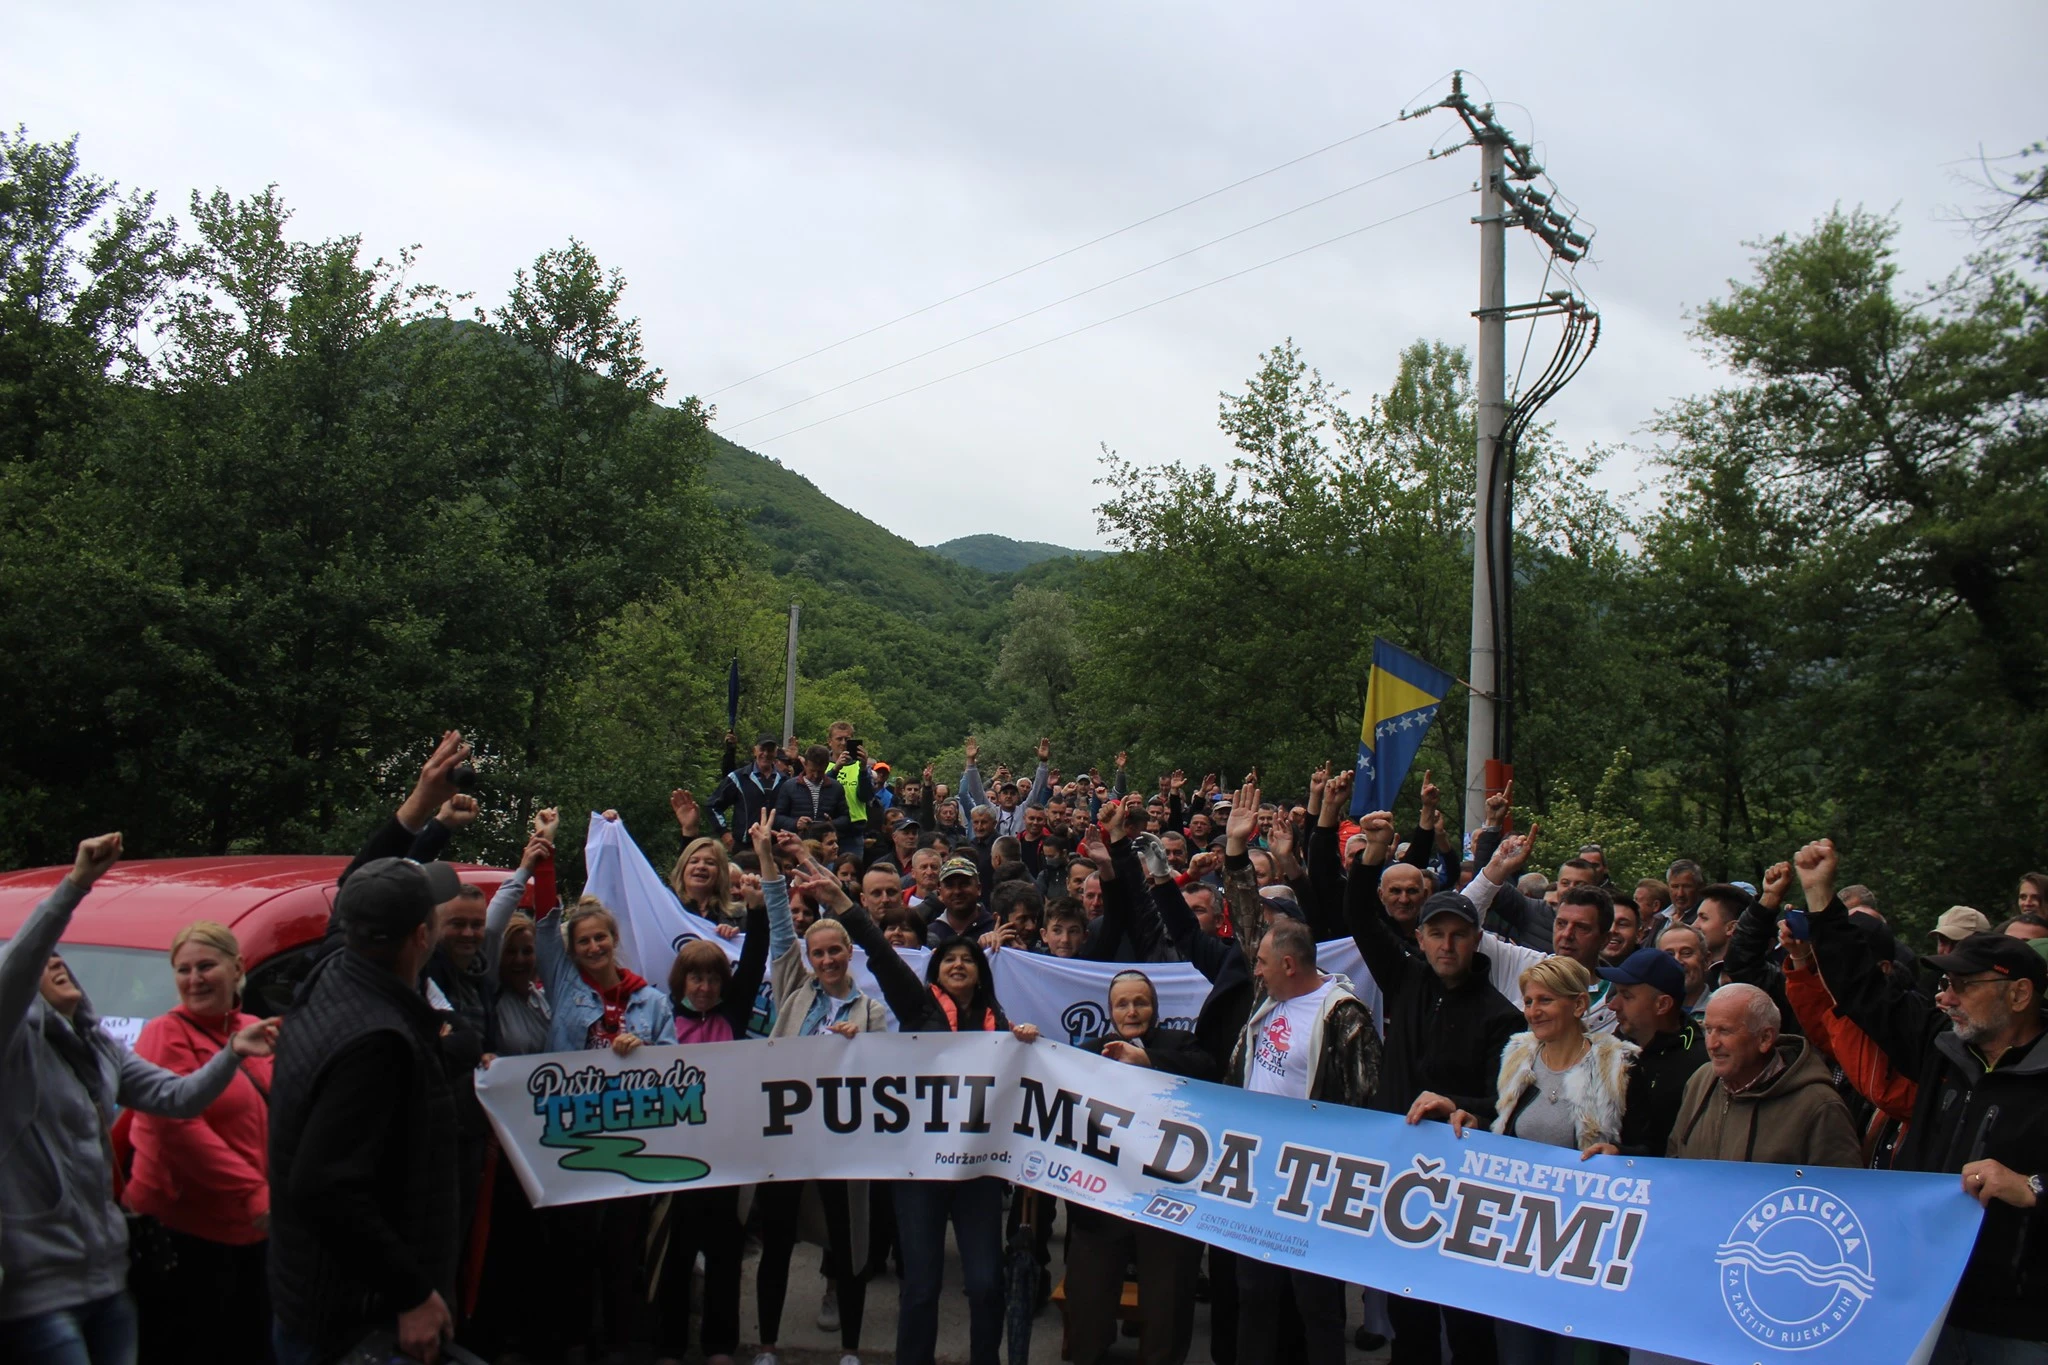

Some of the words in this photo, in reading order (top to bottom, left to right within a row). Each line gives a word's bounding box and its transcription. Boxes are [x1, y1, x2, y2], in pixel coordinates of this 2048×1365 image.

[528, 1062, 607, 1106] Pusti
[619, 1068, 659, 1092] me
[664, 1059, 706, 1089] da
[935, 1151, 988, 1165] Podržano
[990, 1150, 1012, 1164] od:
[762, 1074, 995, 1137] PUSTI
[1012, 1076, 1135, 1167] ME
[1142, 1118, 1260, 1205] DA
[1276, 1144, 1646, 1290] TEČEM!
[1047, 1162, 1107, 1194] USAID
[1461, 1149, 1652, 1205] NERETVICA
[1195, 1221, 1222, 1234] ЦЕНТРИ
[1200, 1212, 1230, 1227] CENTRI
[1230, 1220, 1265, 1238] CIVILNIH
[1264, 1229, 1310, 1249] INICIJATIVA
[1746, 1193, 1861, 1255] KOALICIJA
[1729, 1269, 1739, 1287] ZA
[1731, 1292, 1775, 1339] ZAŠTITU
[1832, 1296, 1852, 1321] BIH
[1781, 1322, 1831, 1343] RIJEKA
